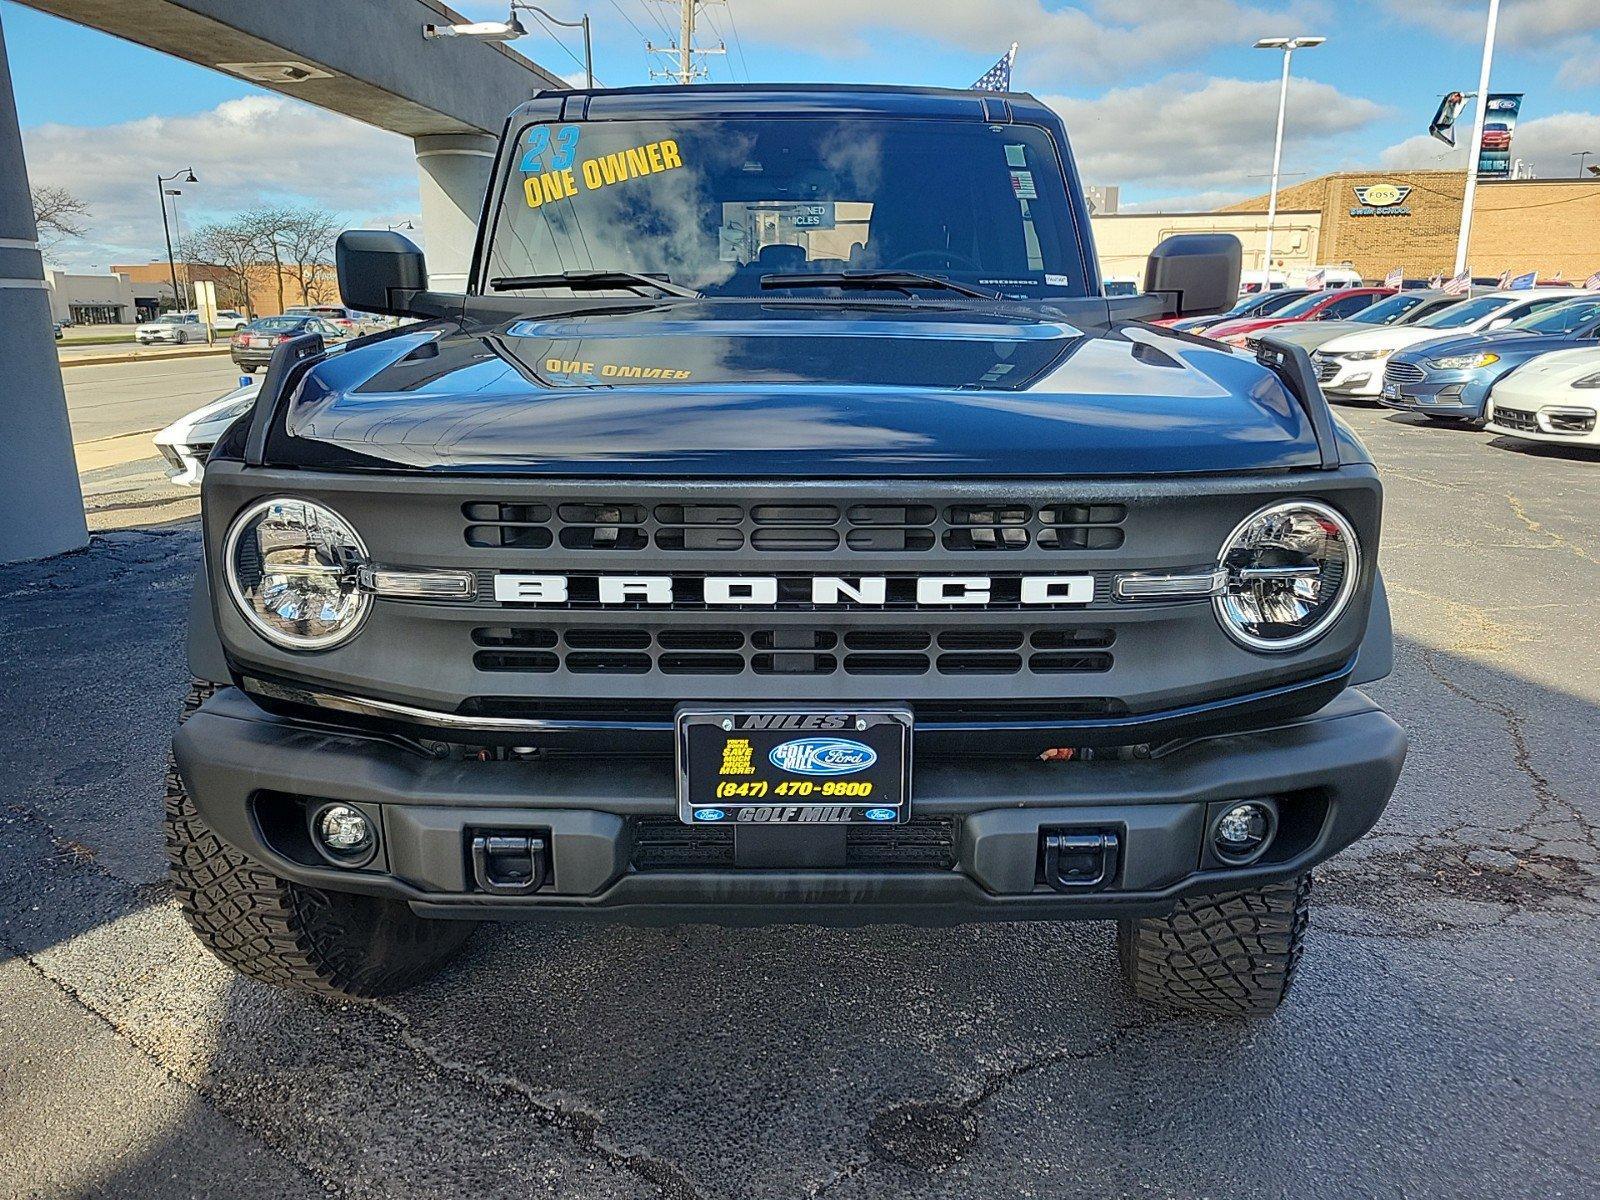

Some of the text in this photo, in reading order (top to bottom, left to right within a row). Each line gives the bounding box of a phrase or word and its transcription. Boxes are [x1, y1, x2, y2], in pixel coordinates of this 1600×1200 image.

[519, 125, 581, 172] 23
[524, 139, 683, 208] ONE OWNER
[1369, 191, 1395, 199] FOSS
[808, 206, 826, 215] NED
[794, 216, 820, 225] ICLES
[494, 573, 1095, 607] BRONCO
[742, 714, 849, 729] NILES
[723, 748, 754, 756] SAVE
[776, 745, 814, 759] GOLF
[824, 749, 863, 763] Ford
[782, 757, 814, 770] MILL
[716, 781, 873, 798] (847) 470-9800
[736, 806, 853, 822] GOLF MILL
